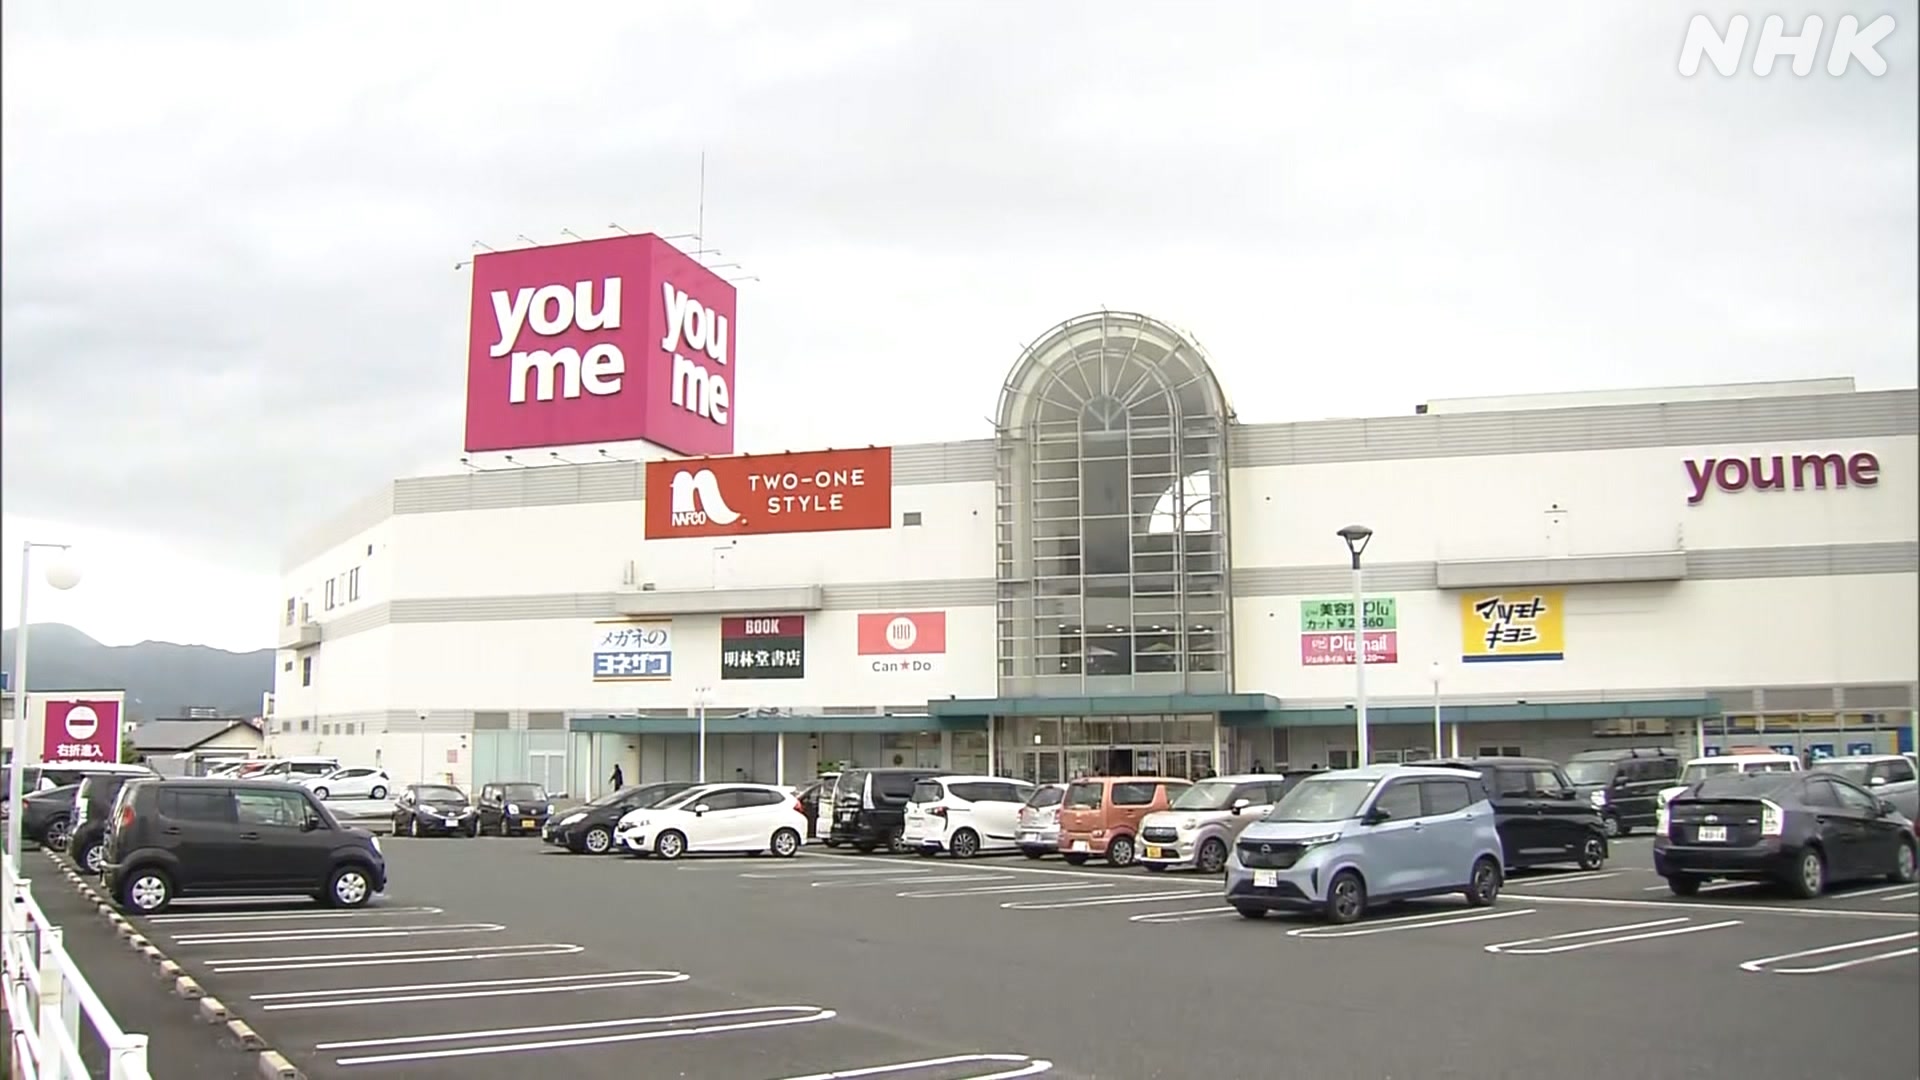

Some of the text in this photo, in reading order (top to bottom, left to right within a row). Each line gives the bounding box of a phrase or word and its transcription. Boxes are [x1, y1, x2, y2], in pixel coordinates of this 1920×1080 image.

[490, 276, 622, 358] you
[661, 281, 728, 365] you
[509, 342, 625, 404] me
[671, 353, 729, 425] me
[748, 469, 865, 492] TWO-ONE
[767, 493, 844, 514] STYLE
[671, 511, 707, 527] NAFCO
[1475, 597, 1546, 624] マツモト
[745, 619, 780, 634] BOOK
[1485, 622, 1537, 649] キヨシ
[601, 629, 667, 648] メガネの
[724, 650, 801, 667] 明林堂書店
[56, 743, 104, 757] 右折進入
